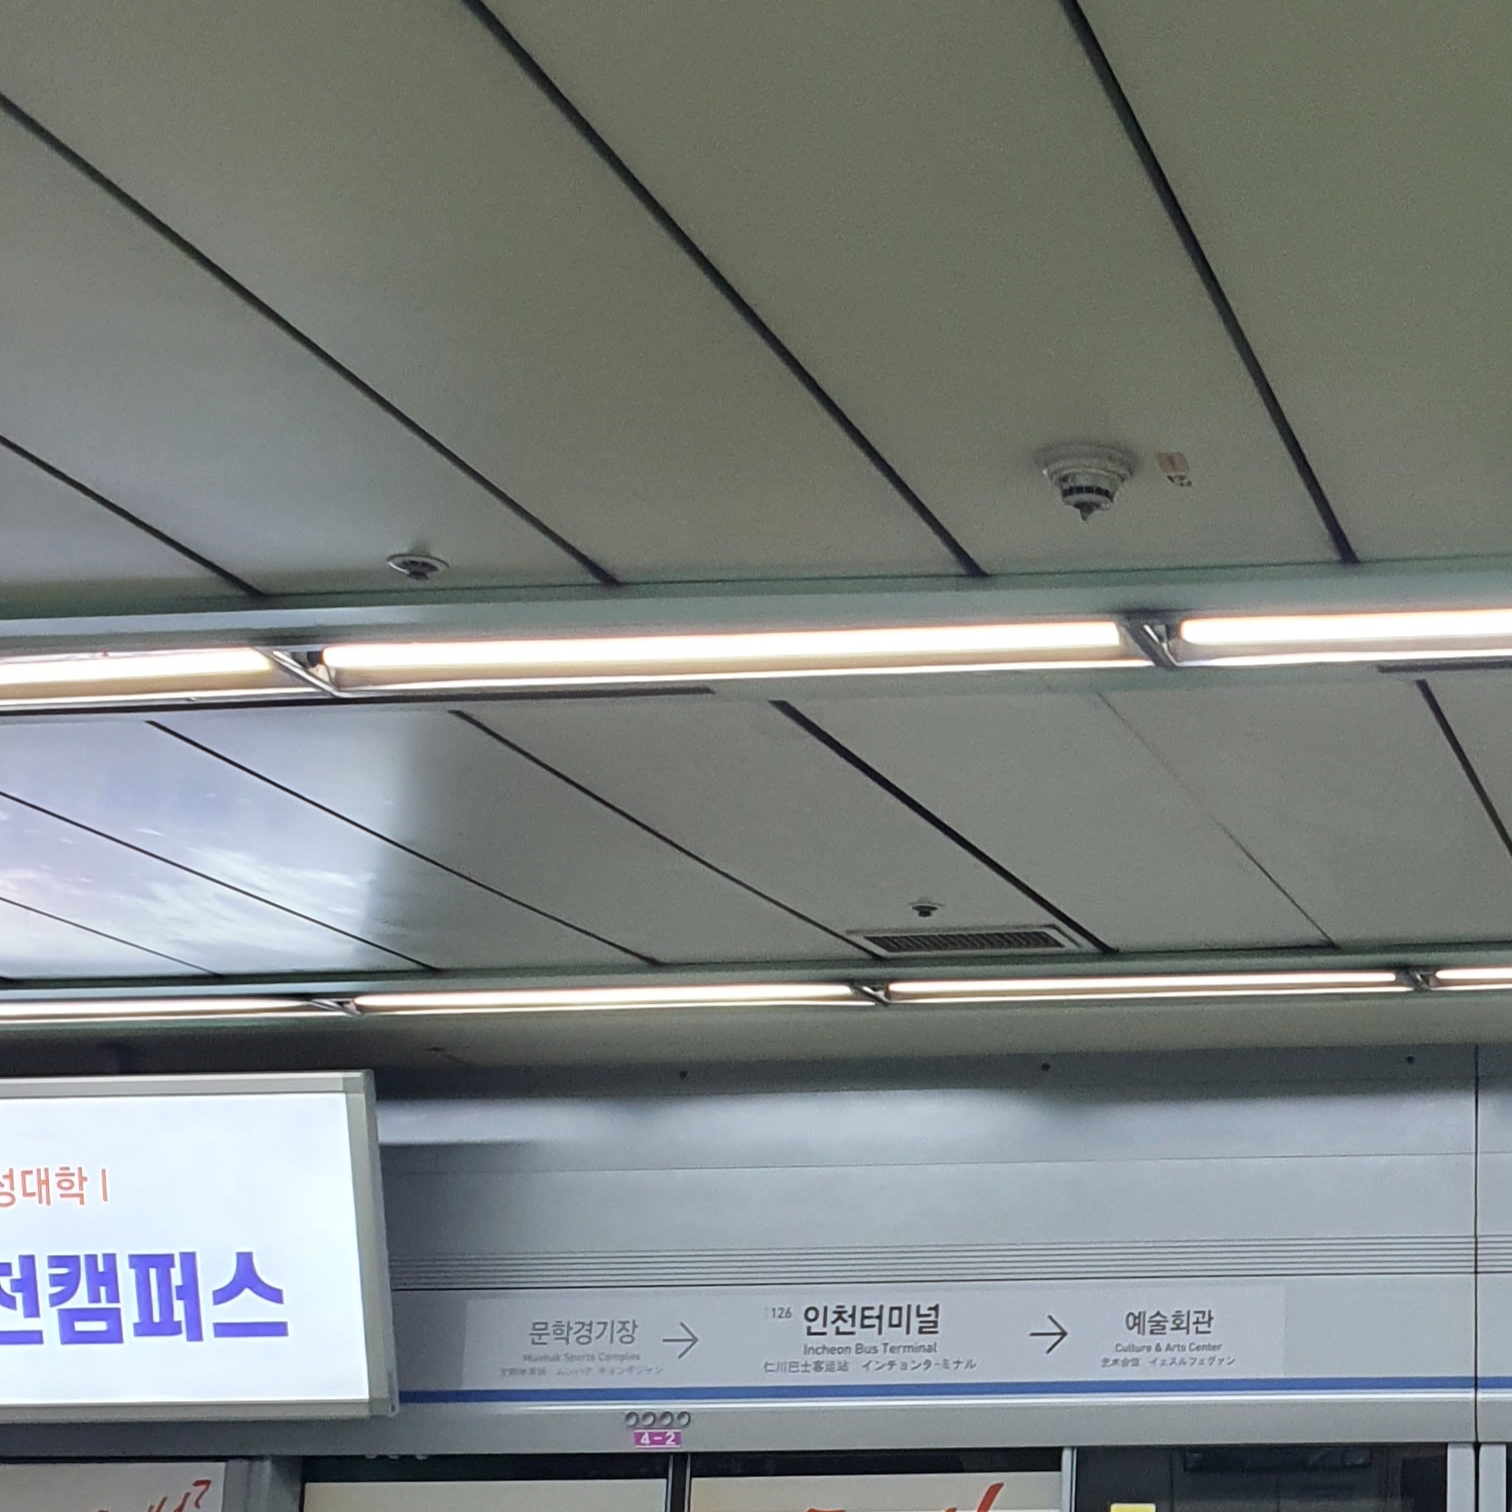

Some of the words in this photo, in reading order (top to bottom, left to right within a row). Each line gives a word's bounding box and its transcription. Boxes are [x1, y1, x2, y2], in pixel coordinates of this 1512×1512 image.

[803, 1304, 940, 1336] 인천터미널
[1125, 1309, 1214, 1335] 예술회관
[529, 1319, 640, 1345] 문학경기장
[803, 1343, 852, 1355] Incheon
[855, 1343, 879, 1354] Bus
[882, 1342, 938, 1353] Terminal
[1115, 1343, 1152, 1352] Culture
[1154, 1343, 1162, 1352] &
[1165, 1343, 1186, 1352] Arts
[1188, 1342, 1223, 1352] Center
[564, 1352, 595, 1362] Sports
[598, 1352, 640, 1362] Complex
[640, 1432, 676, 1445] 4-2
